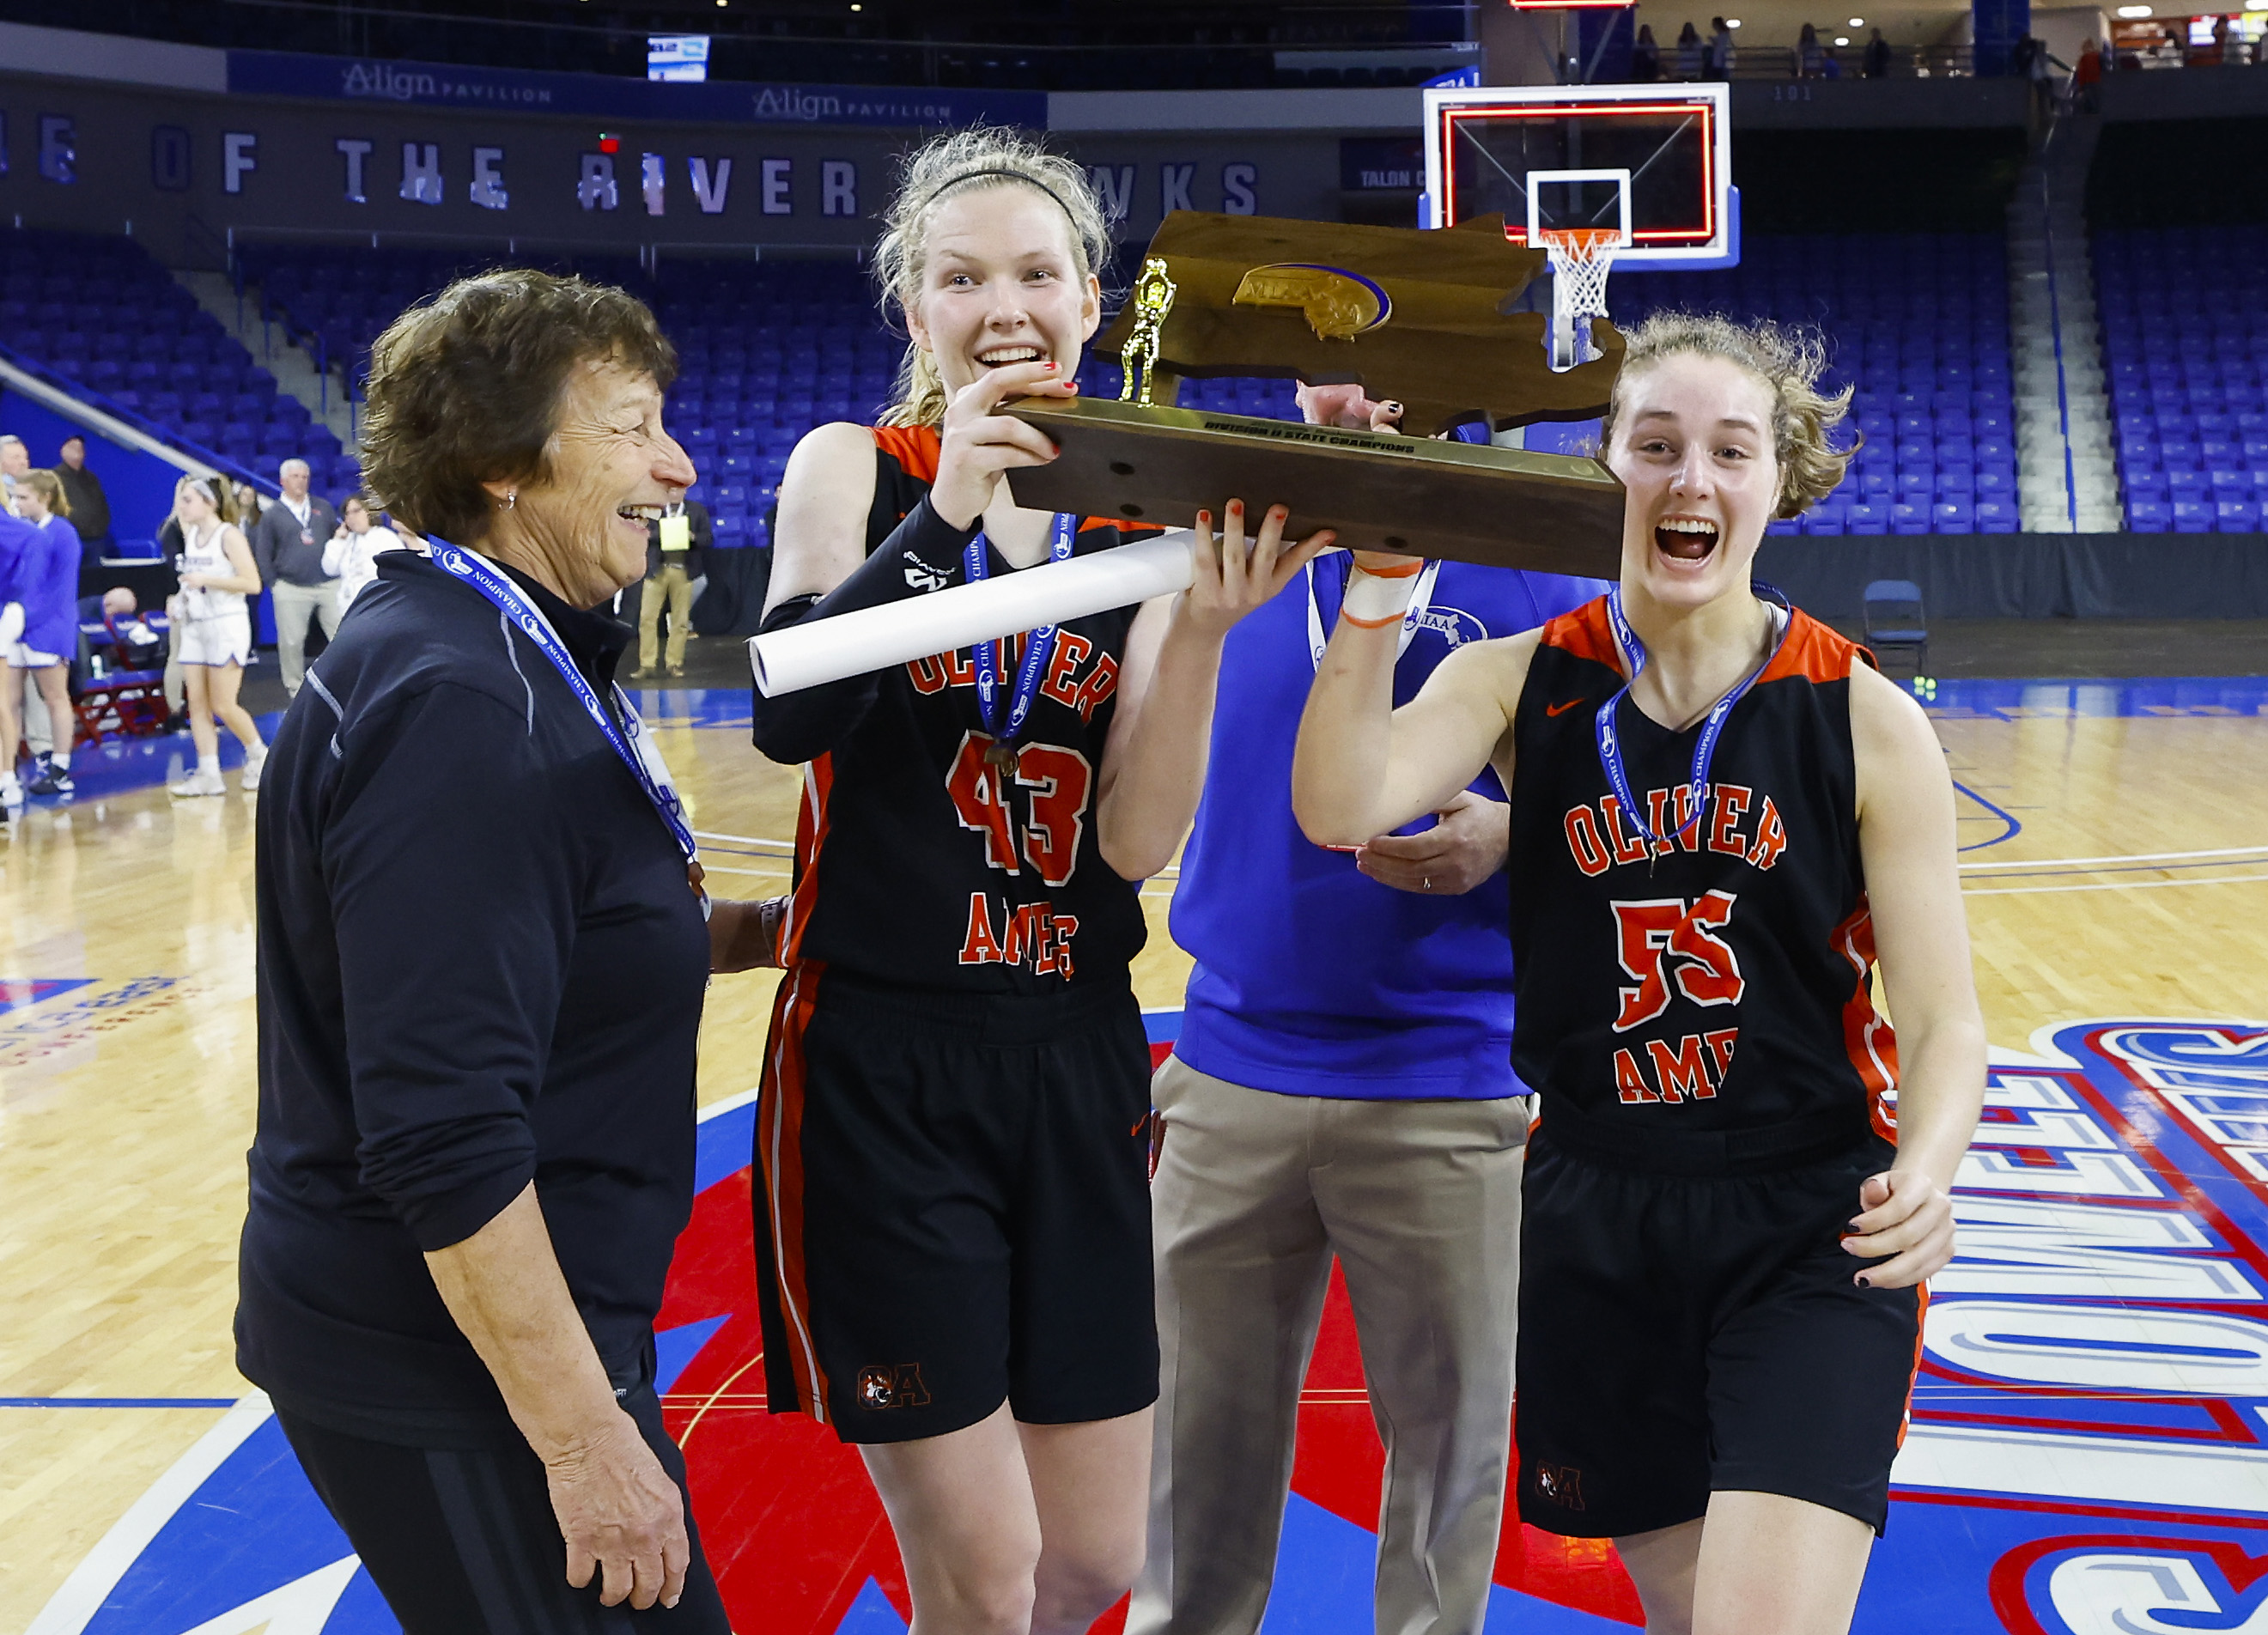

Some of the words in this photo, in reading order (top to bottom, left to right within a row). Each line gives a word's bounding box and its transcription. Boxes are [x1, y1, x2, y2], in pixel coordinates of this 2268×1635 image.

[341, 63, 435, 100] Align
[442, 82, 552, 103] PAVILION
[752, 88, 841, 120] Align
[847, 102, 951, 118] PAVILION
[1773, 85, 1811, 101] 101
[335, 138, 508, 210] THE
[577, 153, 858, 216] RIVER
[1360, 169, 1410, 187] TALON
[1284, 430, 1328, 442] STATE
[1329, 436, 1415, 454] CHAMPIONS
[472, 570, 523, 616] CHAMPION
[547, 645, 586, 694] CHAMPION
[1021, 641, 1043, 693] CHAMPION
[946, 729, 1092, 887] 43
[1608, 759, 1630, 811] CHAMPION
[1564, 783, 1787, 878] OLIVER
[1609, 889, 1745, 1033] 55
